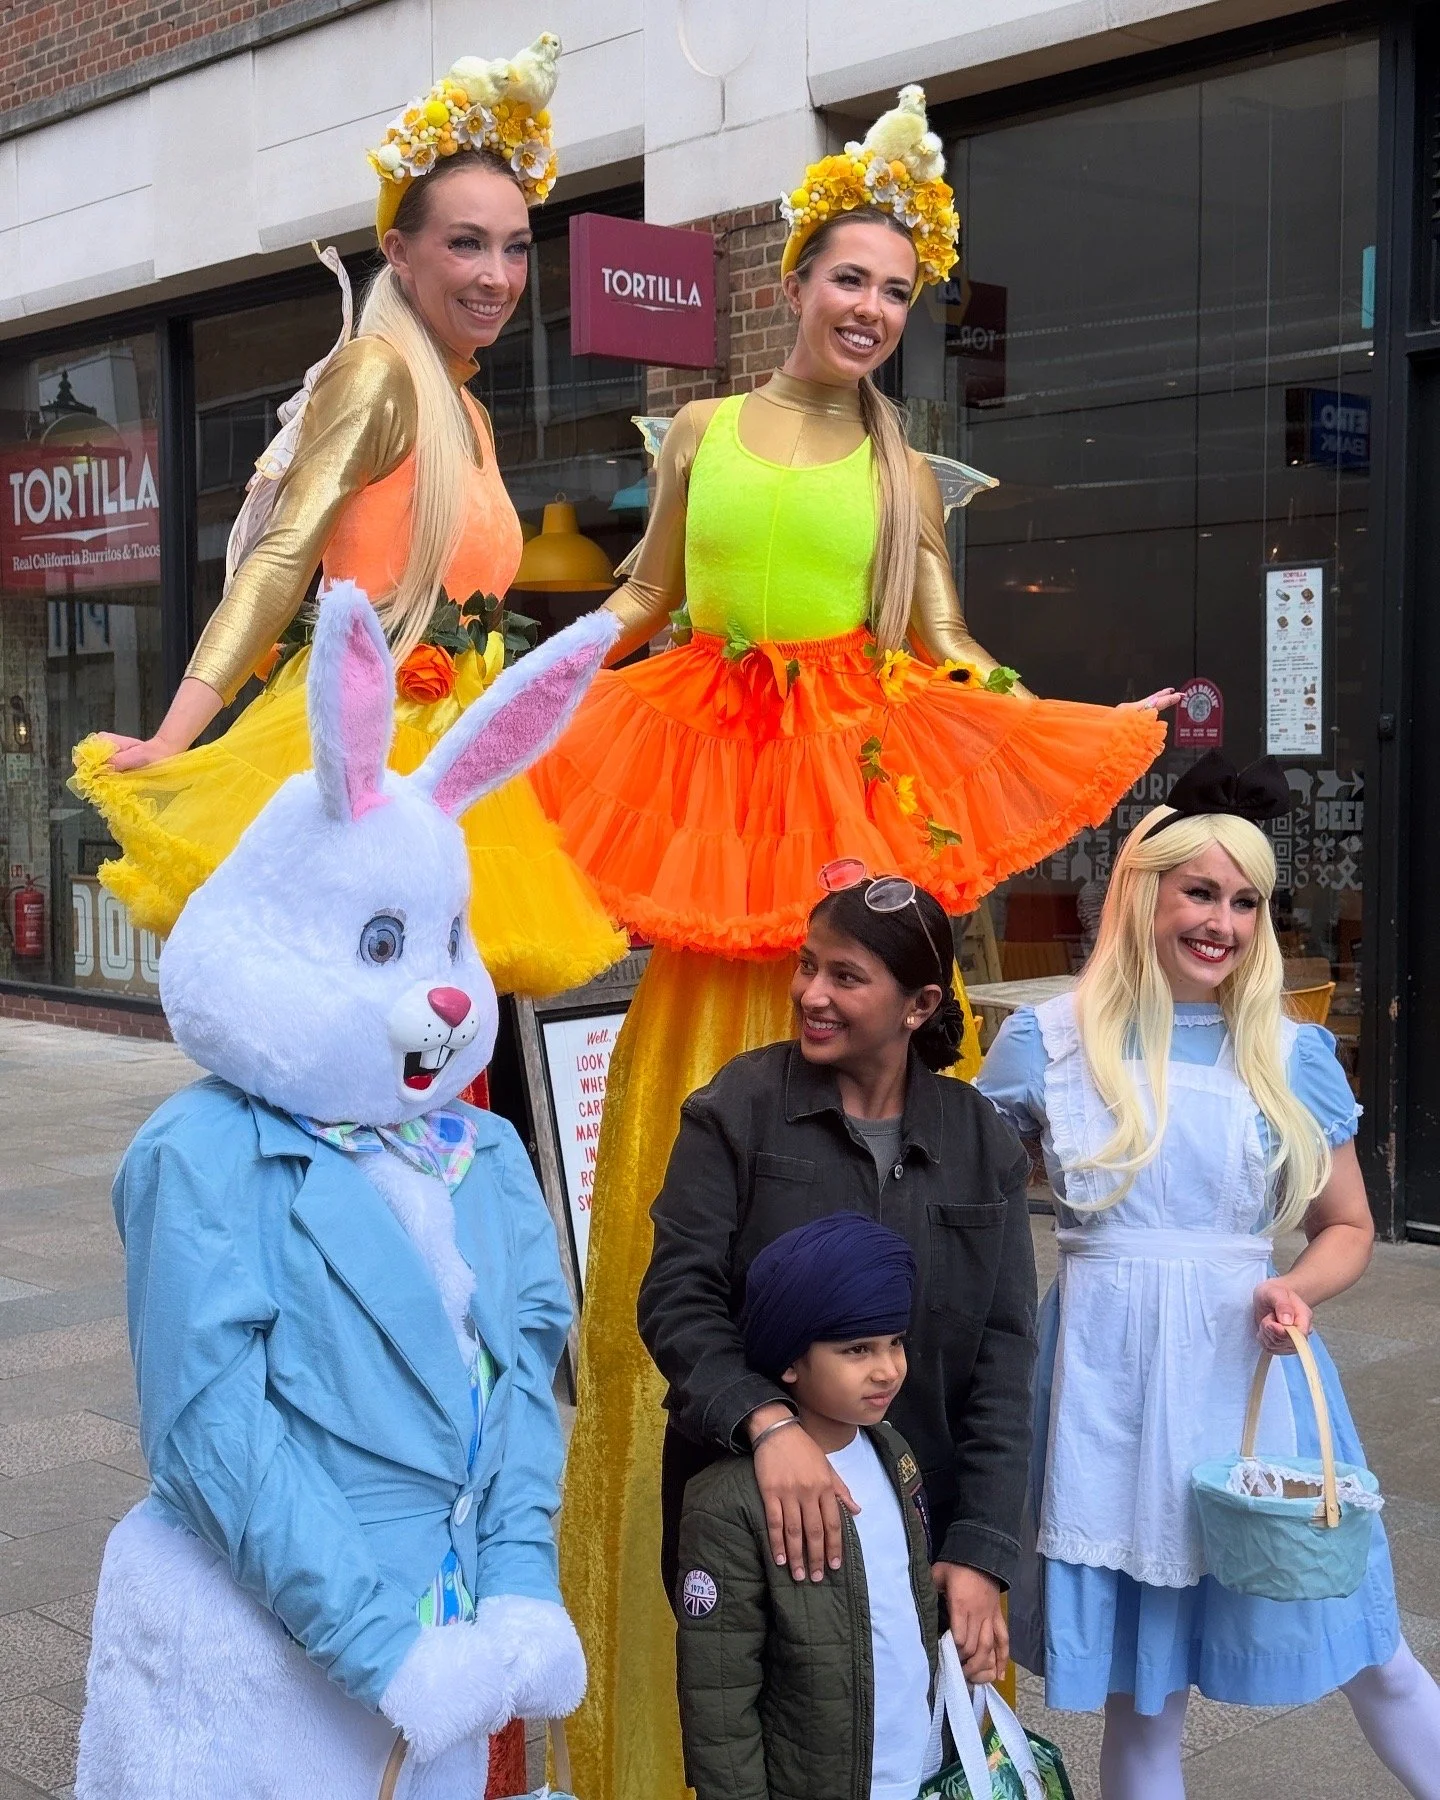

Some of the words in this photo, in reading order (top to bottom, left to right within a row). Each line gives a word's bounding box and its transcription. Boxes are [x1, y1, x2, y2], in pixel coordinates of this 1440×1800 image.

[601, 267, 702, 308] TORTILLA
[9, 452, 159, 526] TORTILLA
[13, 555, 33, 571] Real
[33, 550, 81, 569] California
[81, 548, 122, 565] Burritos
[122, 544, 131, 560] &
[131, 543, 160, 559] Tacos
[577, 1053, 604, 1072] LOOK
[691, 1584, 704, 1595] 1973
